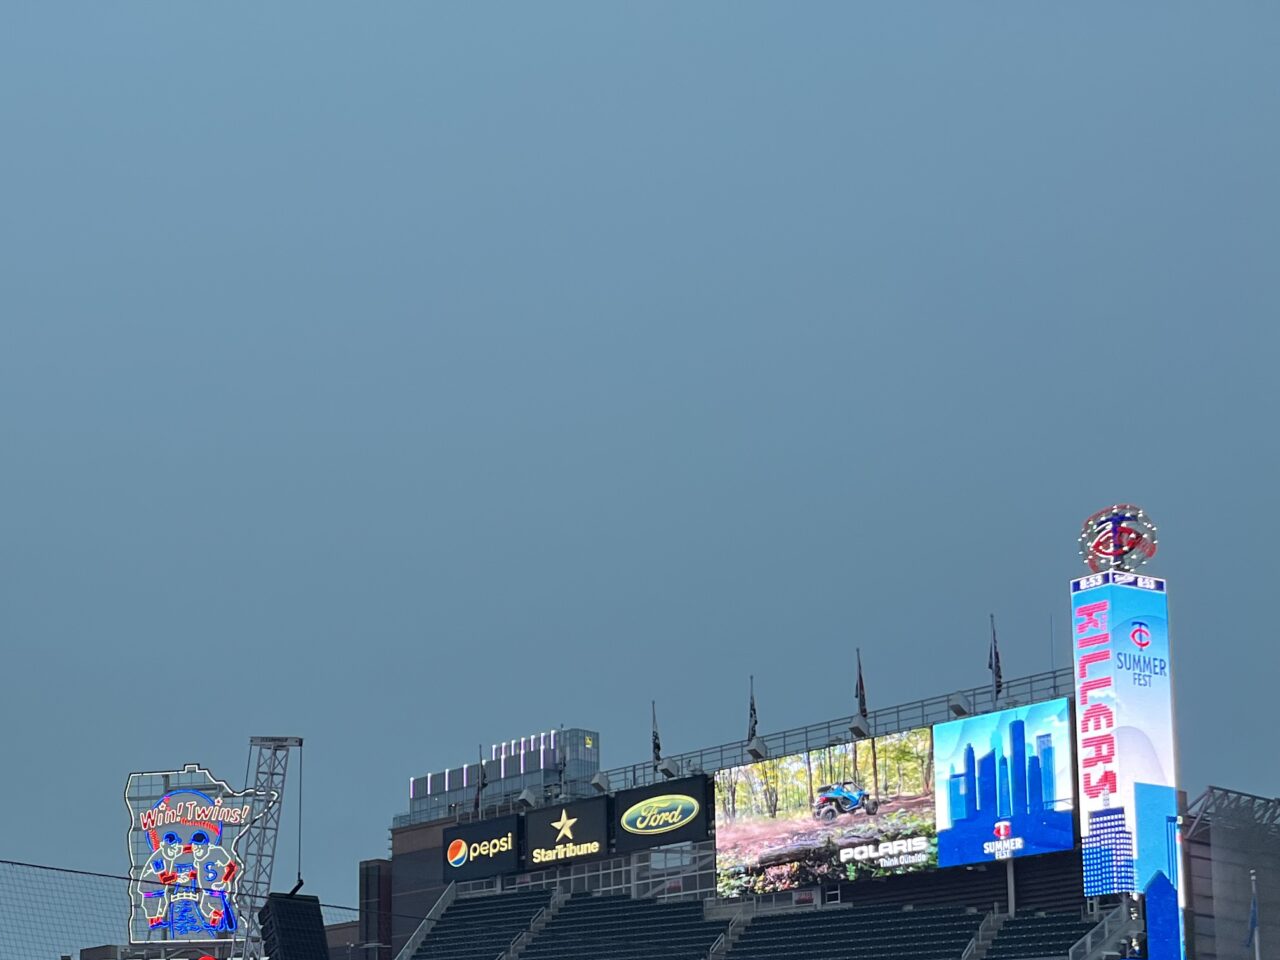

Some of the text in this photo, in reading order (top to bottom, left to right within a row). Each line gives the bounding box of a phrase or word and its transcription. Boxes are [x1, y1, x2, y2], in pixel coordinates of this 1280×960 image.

[1117, 652, 1167, 677] SUMMER
[1132, 672, 1152, 687] FEST
[1075, 600, 1117, 799] KILLERS
[140, 798, 249, 830] Win! Twins!
[635, 802, 682, 829] Ford
[470, 832, 513, 861] pepsi
[839, 836, 929, 863] POLARIS
[983, 838, 1024, 854] SUMMER
[995, 850, 1013, 860] FEST
[878, 852, 928, 868] Think Outside
